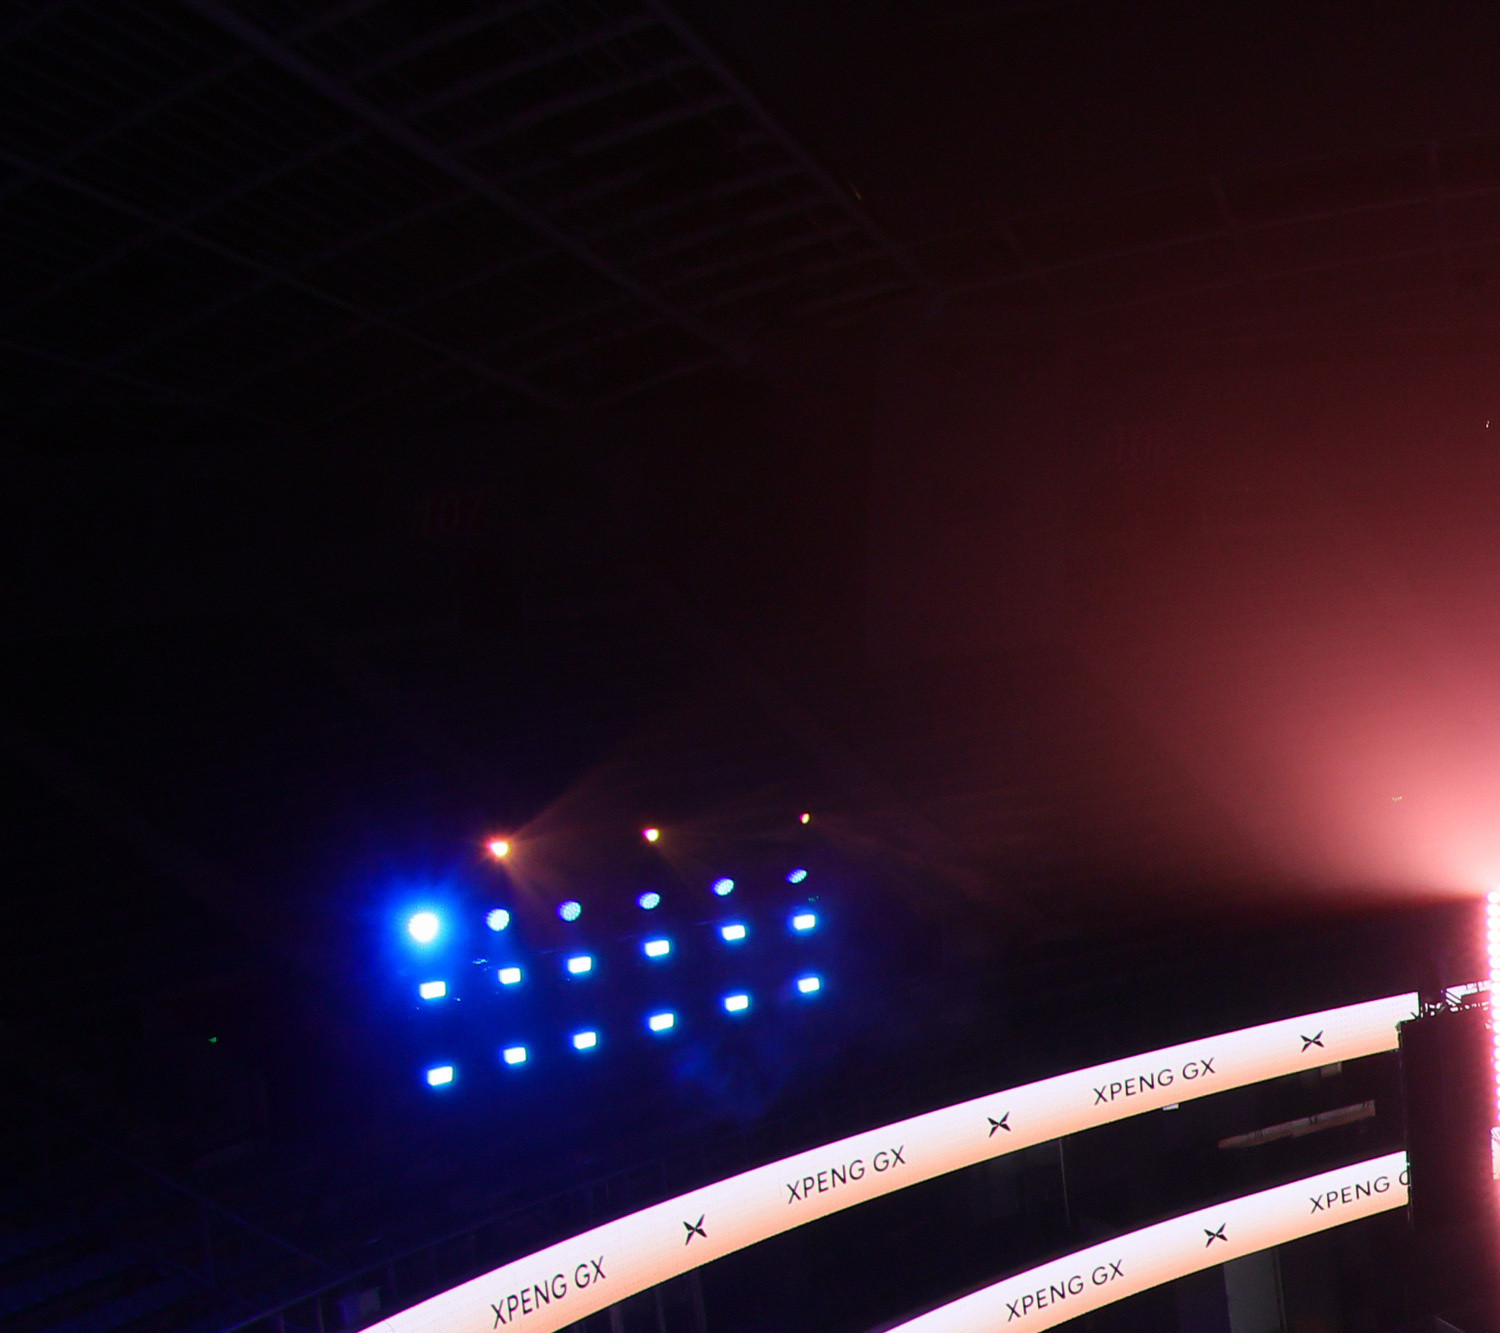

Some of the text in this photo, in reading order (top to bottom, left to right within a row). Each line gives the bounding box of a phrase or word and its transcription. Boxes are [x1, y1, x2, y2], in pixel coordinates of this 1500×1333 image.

[1093, 1057, 1216, 1106] XPENG GX
[786, 1145, 906, 1205] XPENG GX
[1309, 1175, 1391, 1214] XPENG
[490, 1255, 607, 1330] XPENG GX
[1005, 1259, 1125, 1323] XPENG GX
